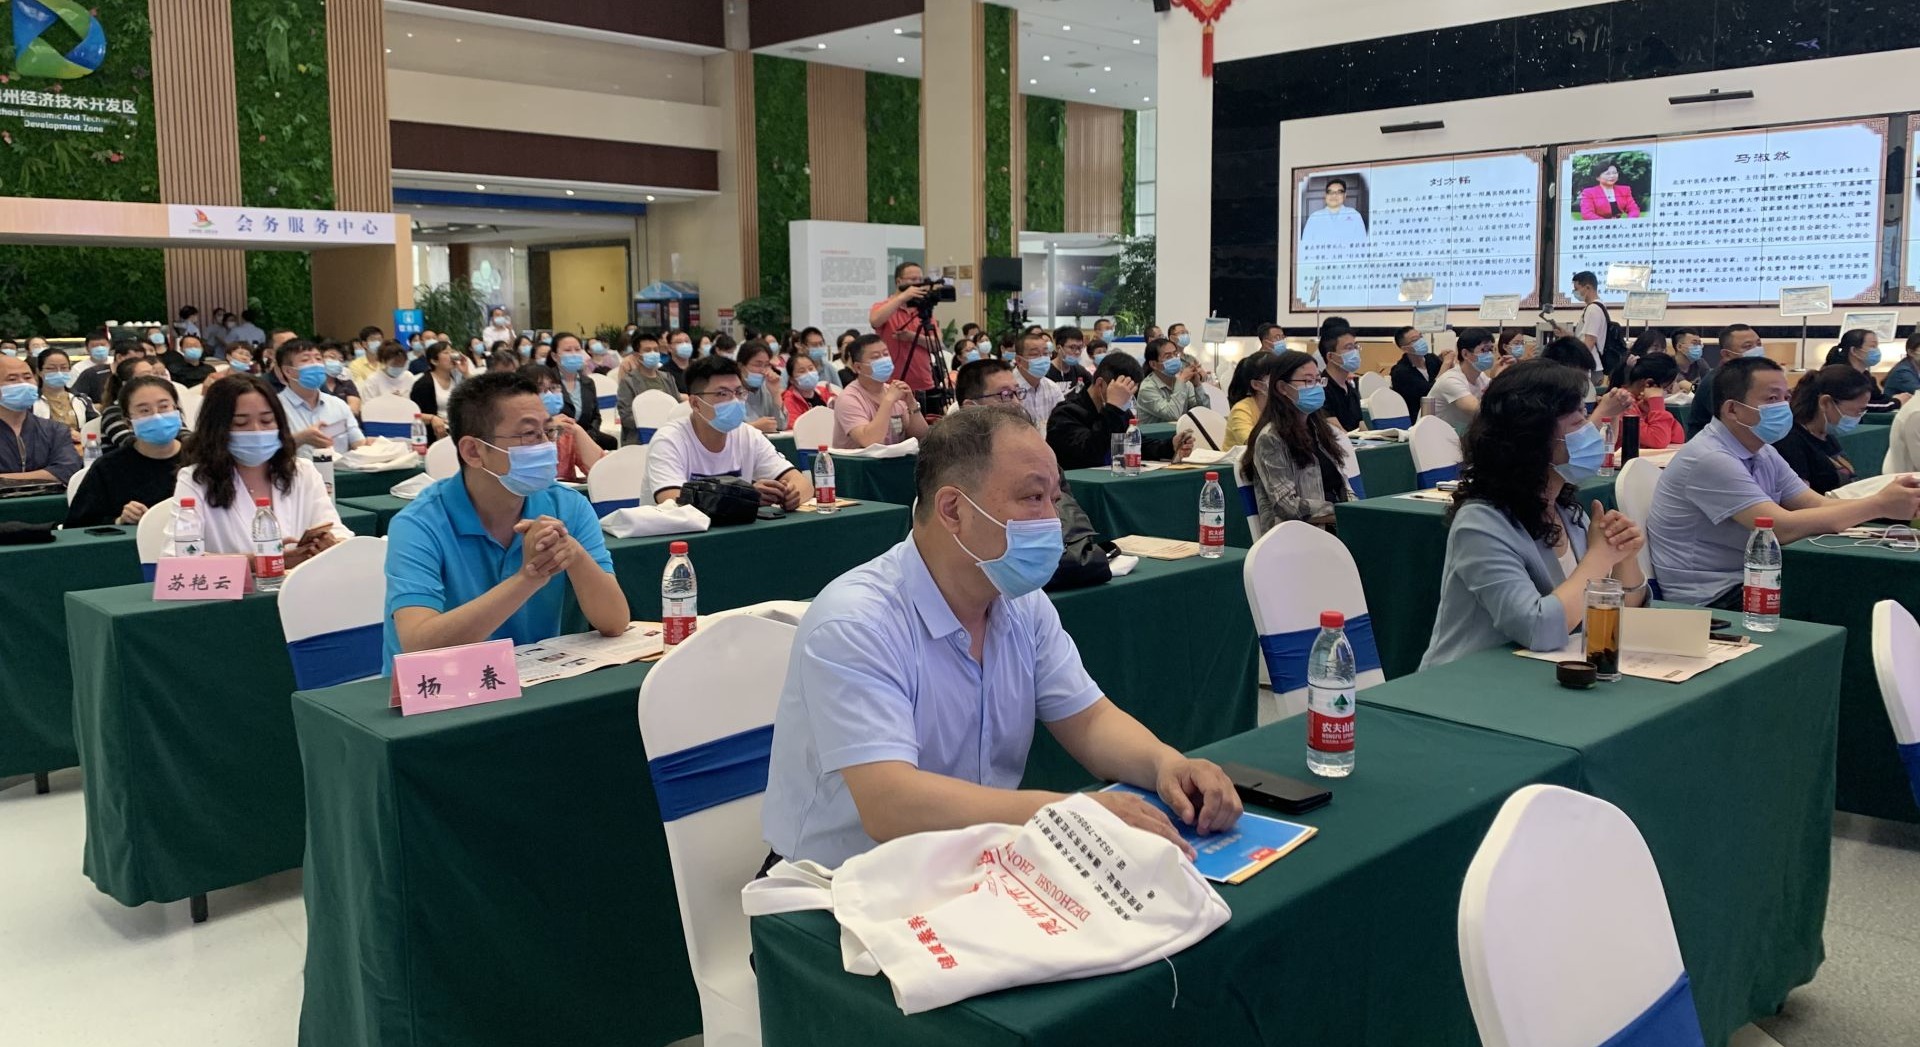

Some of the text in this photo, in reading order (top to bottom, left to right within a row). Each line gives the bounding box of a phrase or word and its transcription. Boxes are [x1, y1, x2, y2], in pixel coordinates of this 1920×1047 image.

[0, 88, 137, 114] 州经济技术开发区
[20, 109, 62, 120] Economic
[63, 112, 80, 122] And
[24, 119, 104, 133] Development Zone
[1733, 149, 1791, 164] 马淑然
[236, 213, 379, 235] 会务服务中心
[168, 573, 231, 591] 苏艳云
[1034, 873, 1091, 922] DEZHOUSHI
[907, 914, 959, 970] 健康素养
